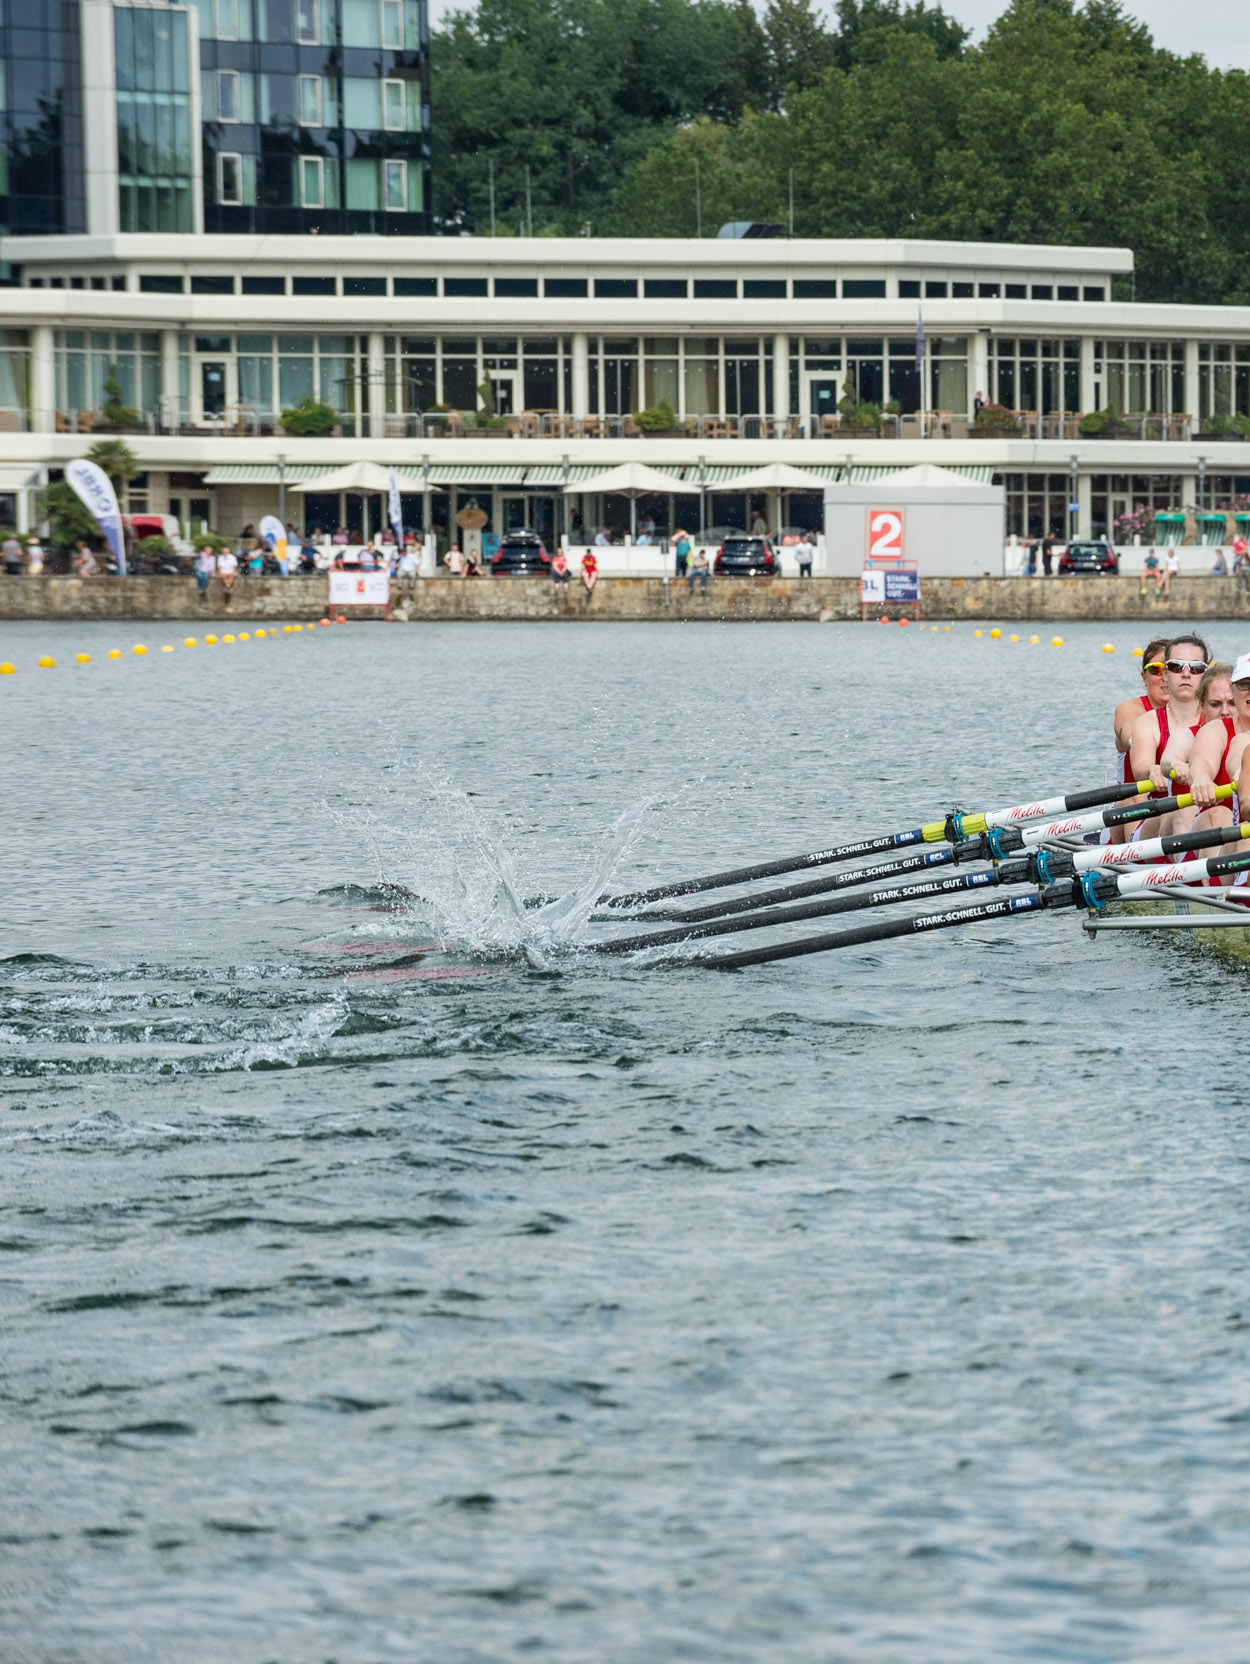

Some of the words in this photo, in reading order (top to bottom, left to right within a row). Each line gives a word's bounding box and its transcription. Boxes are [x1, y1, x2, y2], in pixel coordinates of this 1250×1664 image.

[871, 513, 902, 556] 2
[1007, 802, 1047, 822] Melitta
[1044, 818, 1084, 839] Melitta
[809, 849, 837, 862] STARK.
[837, 841, 873, 856] SCHNELL.
[873, 837, 892, 850] GUT.
[900, 832, 915, 841] RBL
[1099, 845, 1142, 866] Melitta
[839, 869, 865, 882] STARK.
[866, 862, 902, 877] SCHNELL.
[902, 857, 921, 869] GUT.
[1142, 867, 1186, 889] Melitta
[872, 889, 902, 902] STARK.
[902, 881, 942, 896] SCHNELL.
[943, 878, 963, 889] GUT.
[972, 873, 989, 882] RBL
[916, 914, 946, 928] STARK.
[946, 906, 985, 922] SCHNELL.
[986, 901, 1006, 914] GUT.
[1015, 896, 1032, 906] RBL
